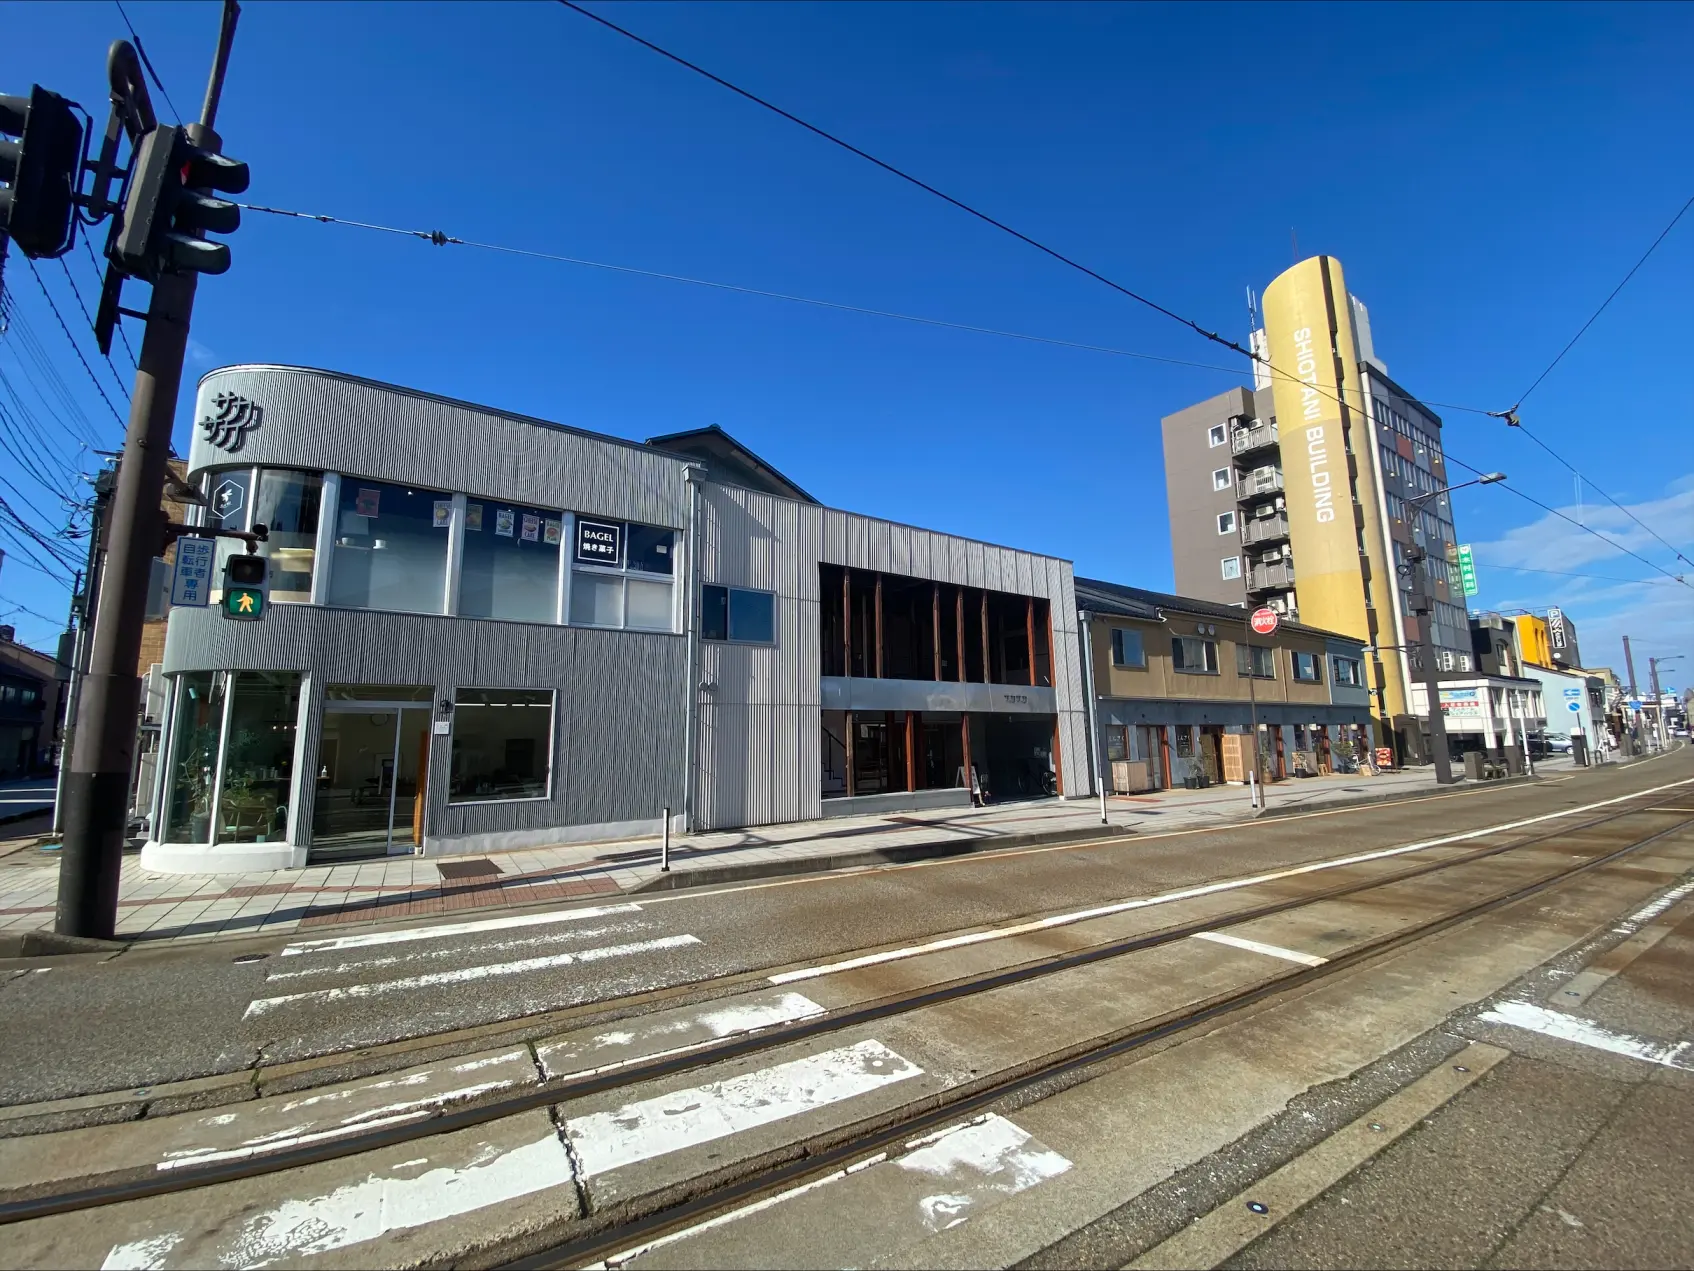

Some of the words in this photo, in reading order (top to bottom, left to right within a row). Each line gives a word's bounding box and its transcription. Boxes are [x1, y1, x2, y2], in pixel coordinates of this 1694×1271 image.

[1294, 327, 1321, 421] SHIOTANI
[1306, 425, 1334, 524] BUILDING
[499, 512, 512, 520] BAGEL
[583, 542, 614, 554] 焼き菓子
[584, 530, 614, 542] BAGEL
[180, 544, 195, 577] 自転車
[194, 545, 210, 579] 歩行者
